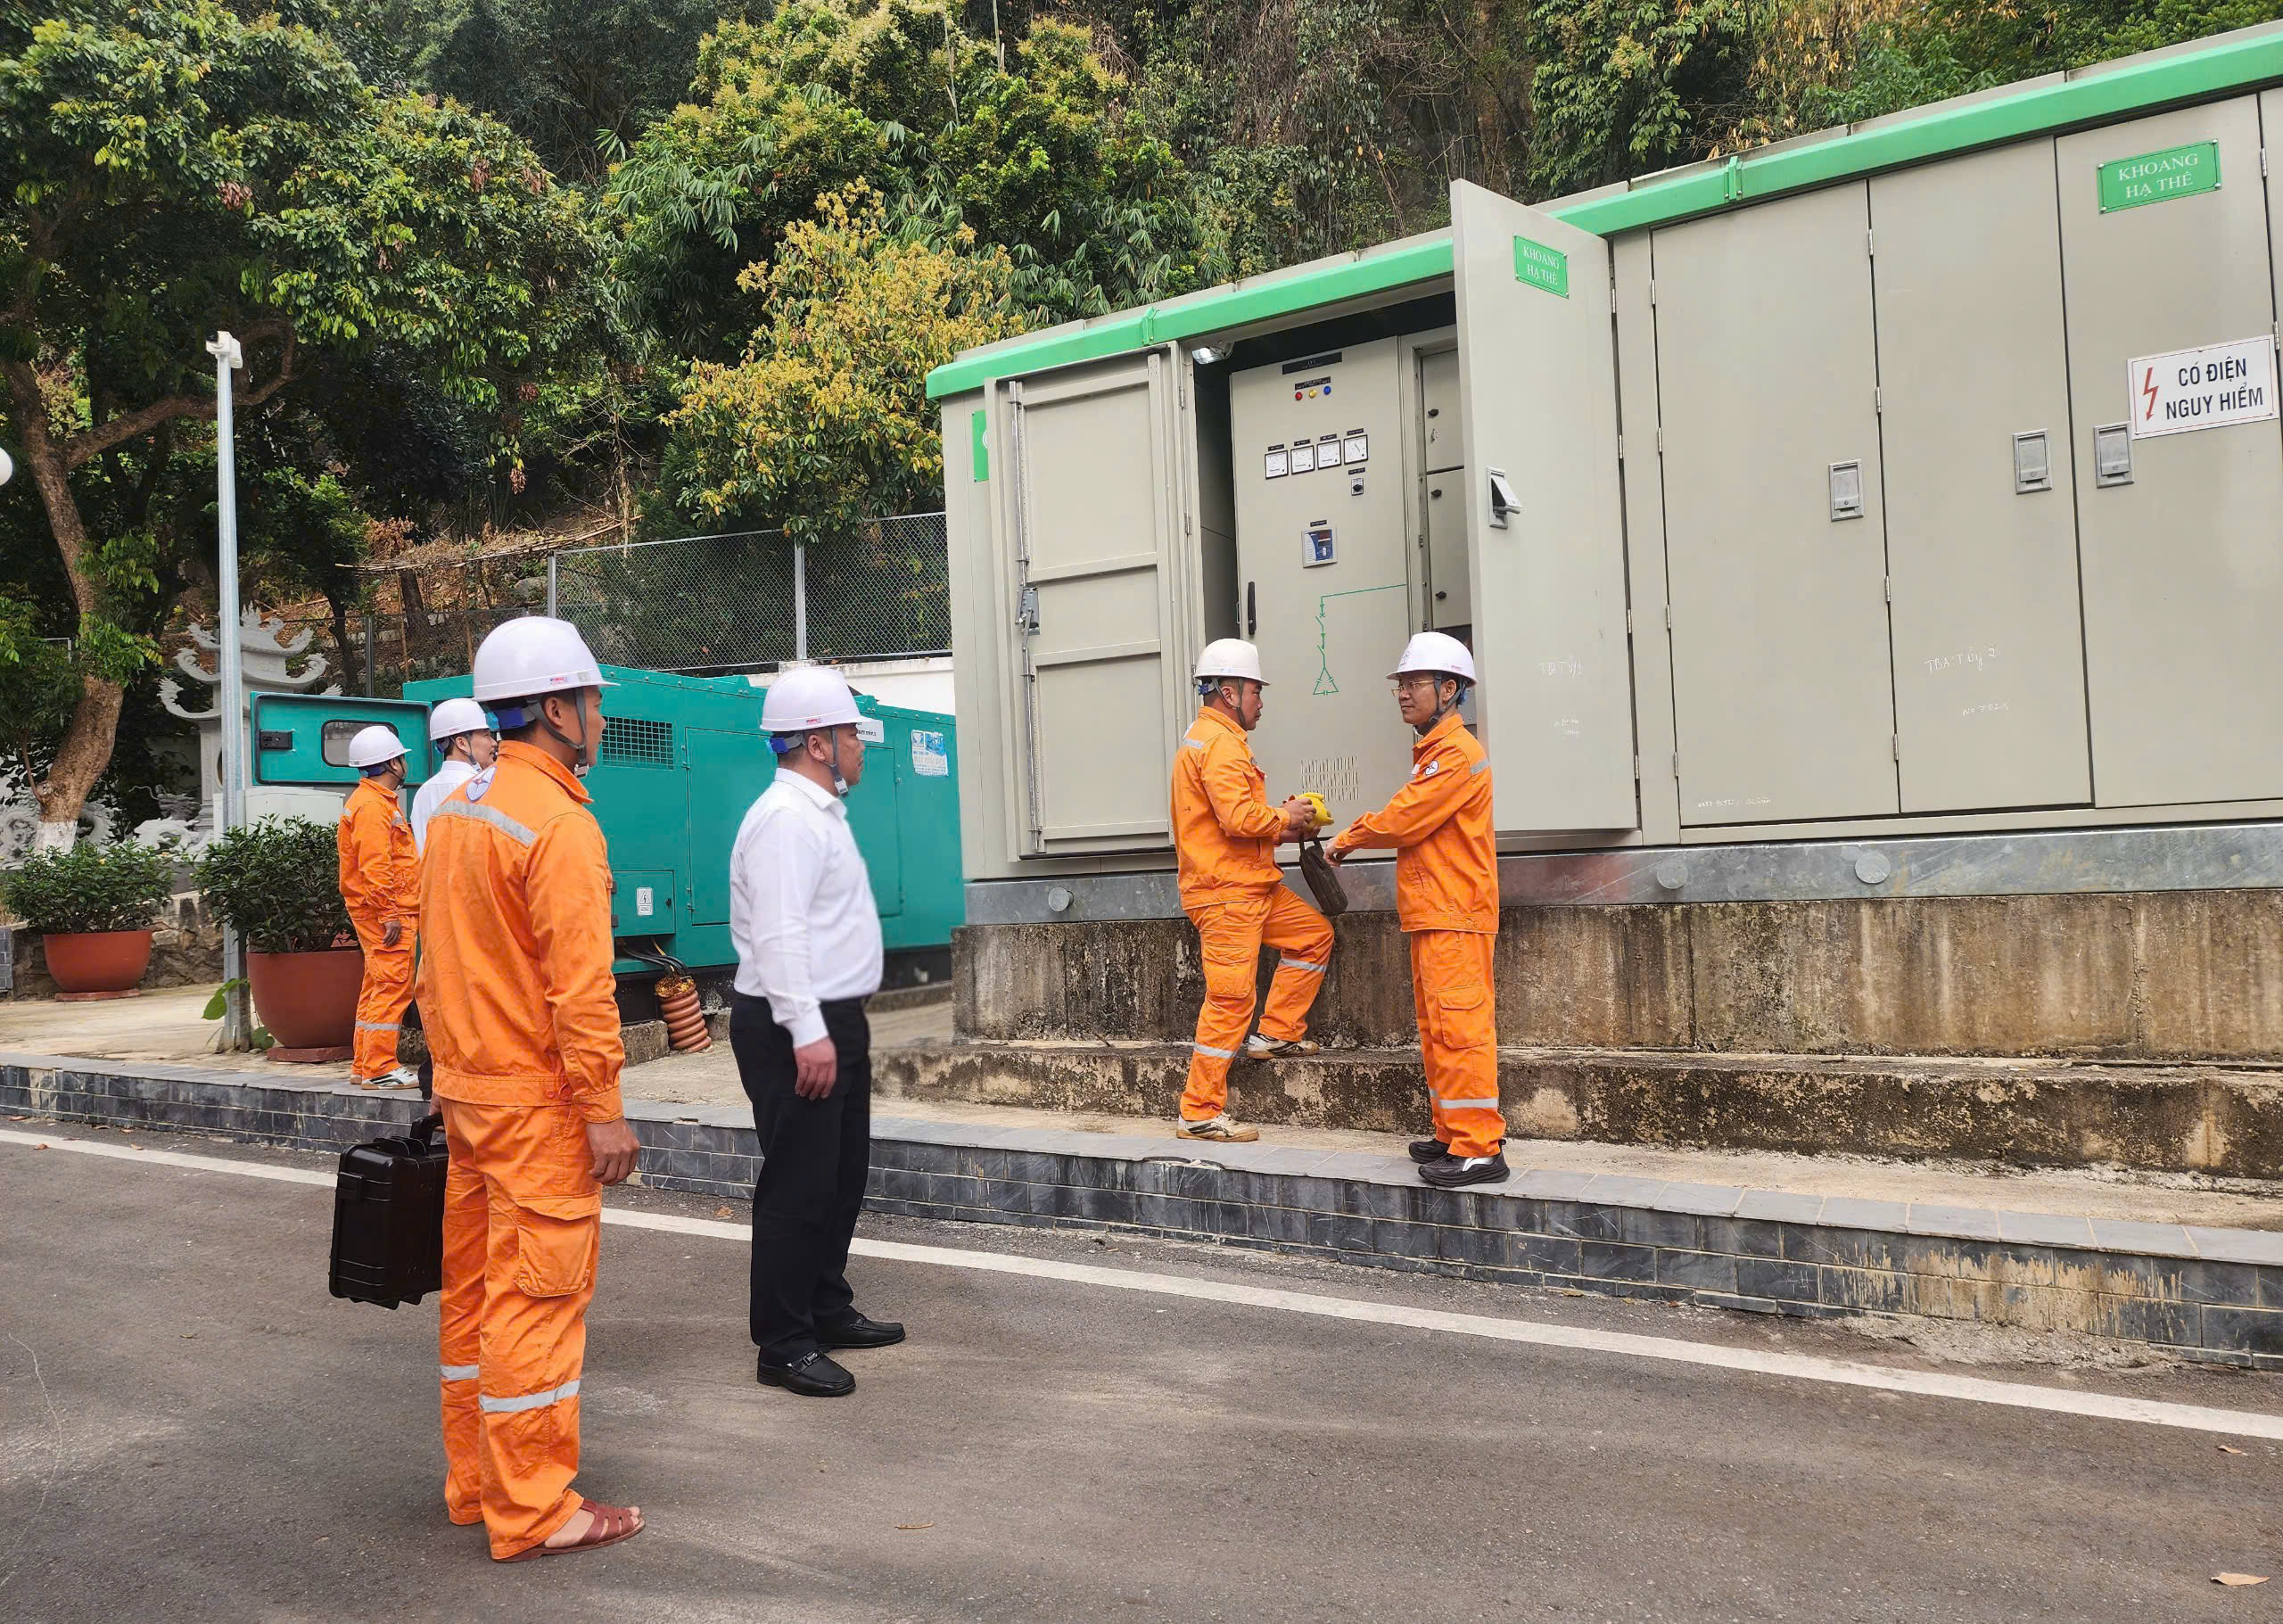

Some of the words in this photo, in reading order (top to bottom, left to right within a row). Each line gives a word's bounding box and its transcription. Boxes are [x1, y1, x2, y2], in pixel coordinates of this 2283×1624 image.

[2118, 153, 2198, 181] KHOANG
[2125, 183, 2152, 198] HẠ
[1523, 245, 1560, 269] KHOANG
[1527, 263, 1540, 280] HẠ
[2178, 360, 2201, 387] CÓ
[2205, 356, 2246, 383] ĐIỆN
[2166, 394, 2213, 420] NGUY
[2220, 381, 2263, 412] HIỂM
